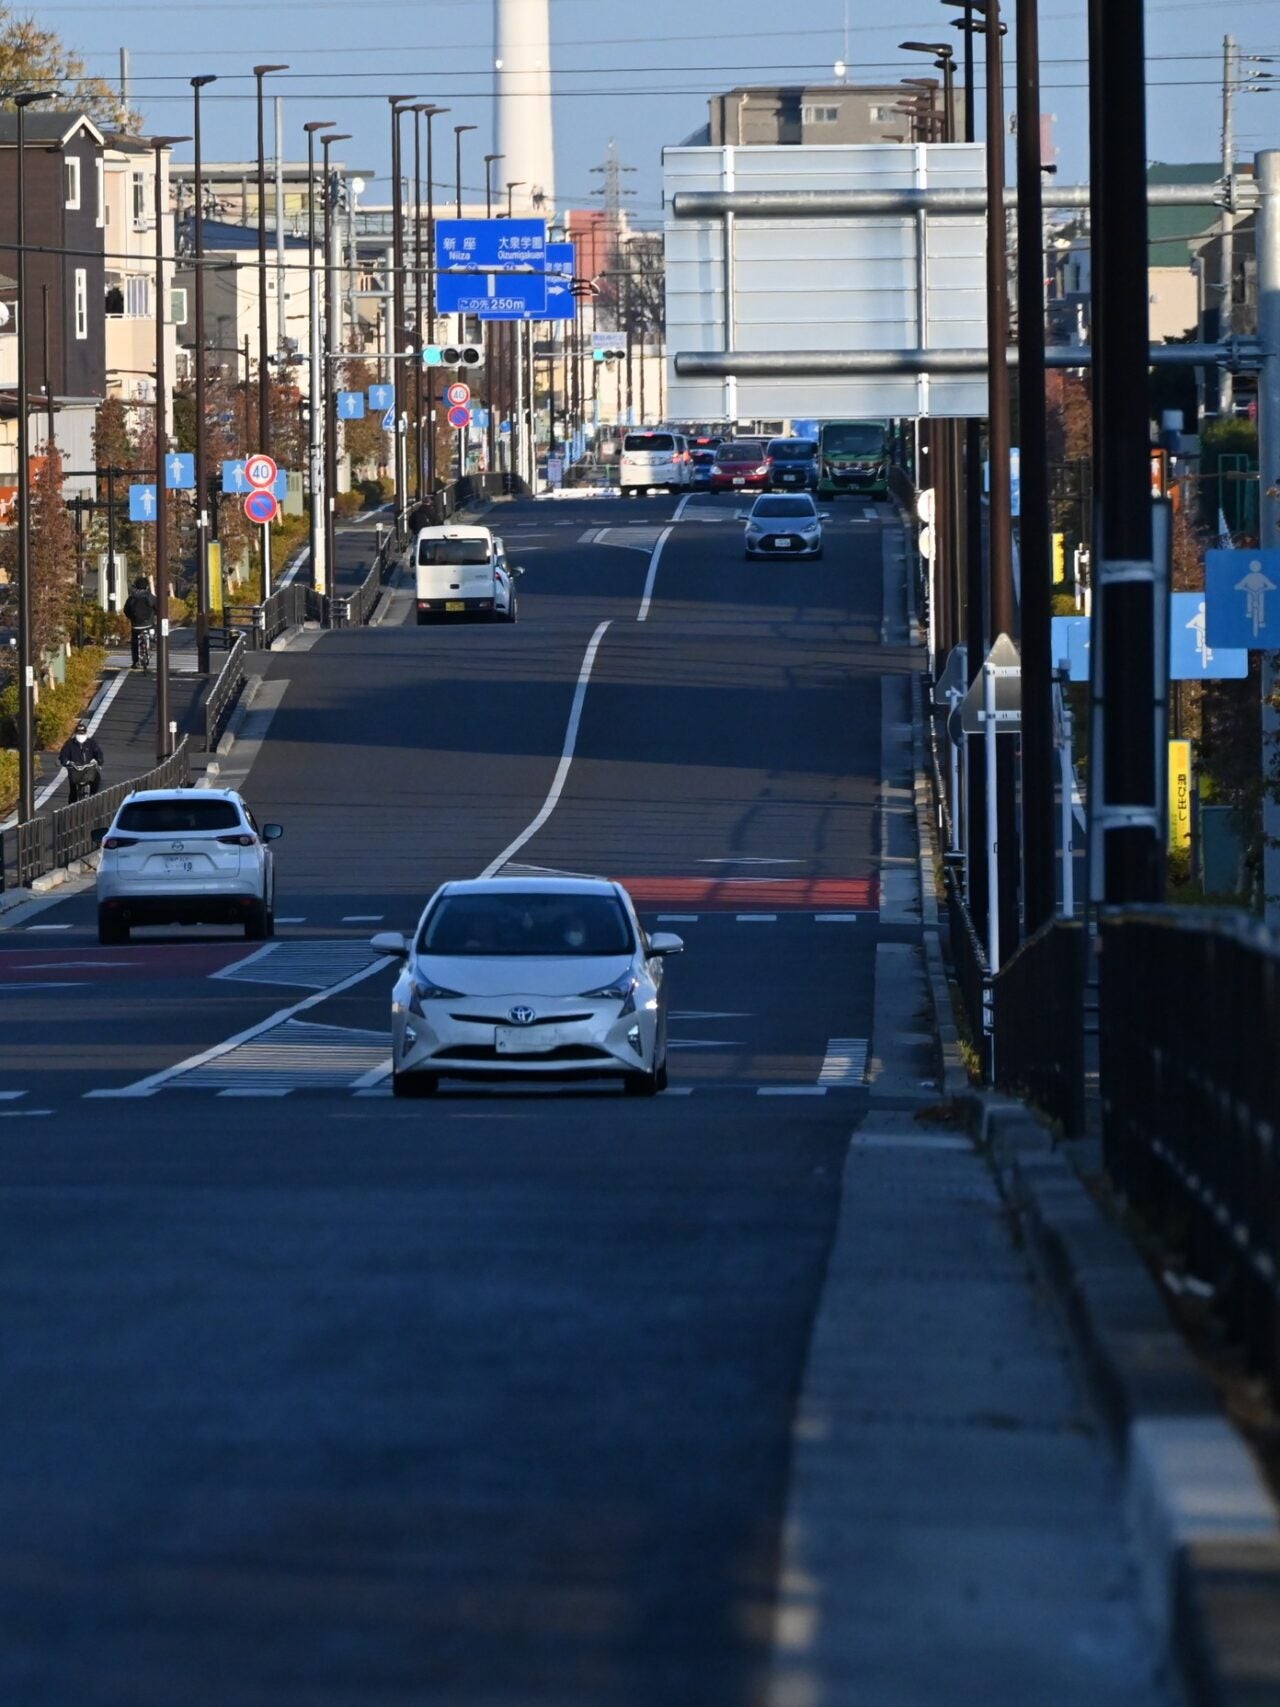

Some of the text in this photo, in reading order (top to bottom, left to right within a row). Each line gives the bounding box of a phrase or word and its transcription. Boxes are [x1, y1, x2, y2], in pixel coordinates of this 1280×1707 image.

[443, 236, 476, 251] 新座
[498, 236, 543, 250] 大泉学園
[252, 464, 269, 479] 40
